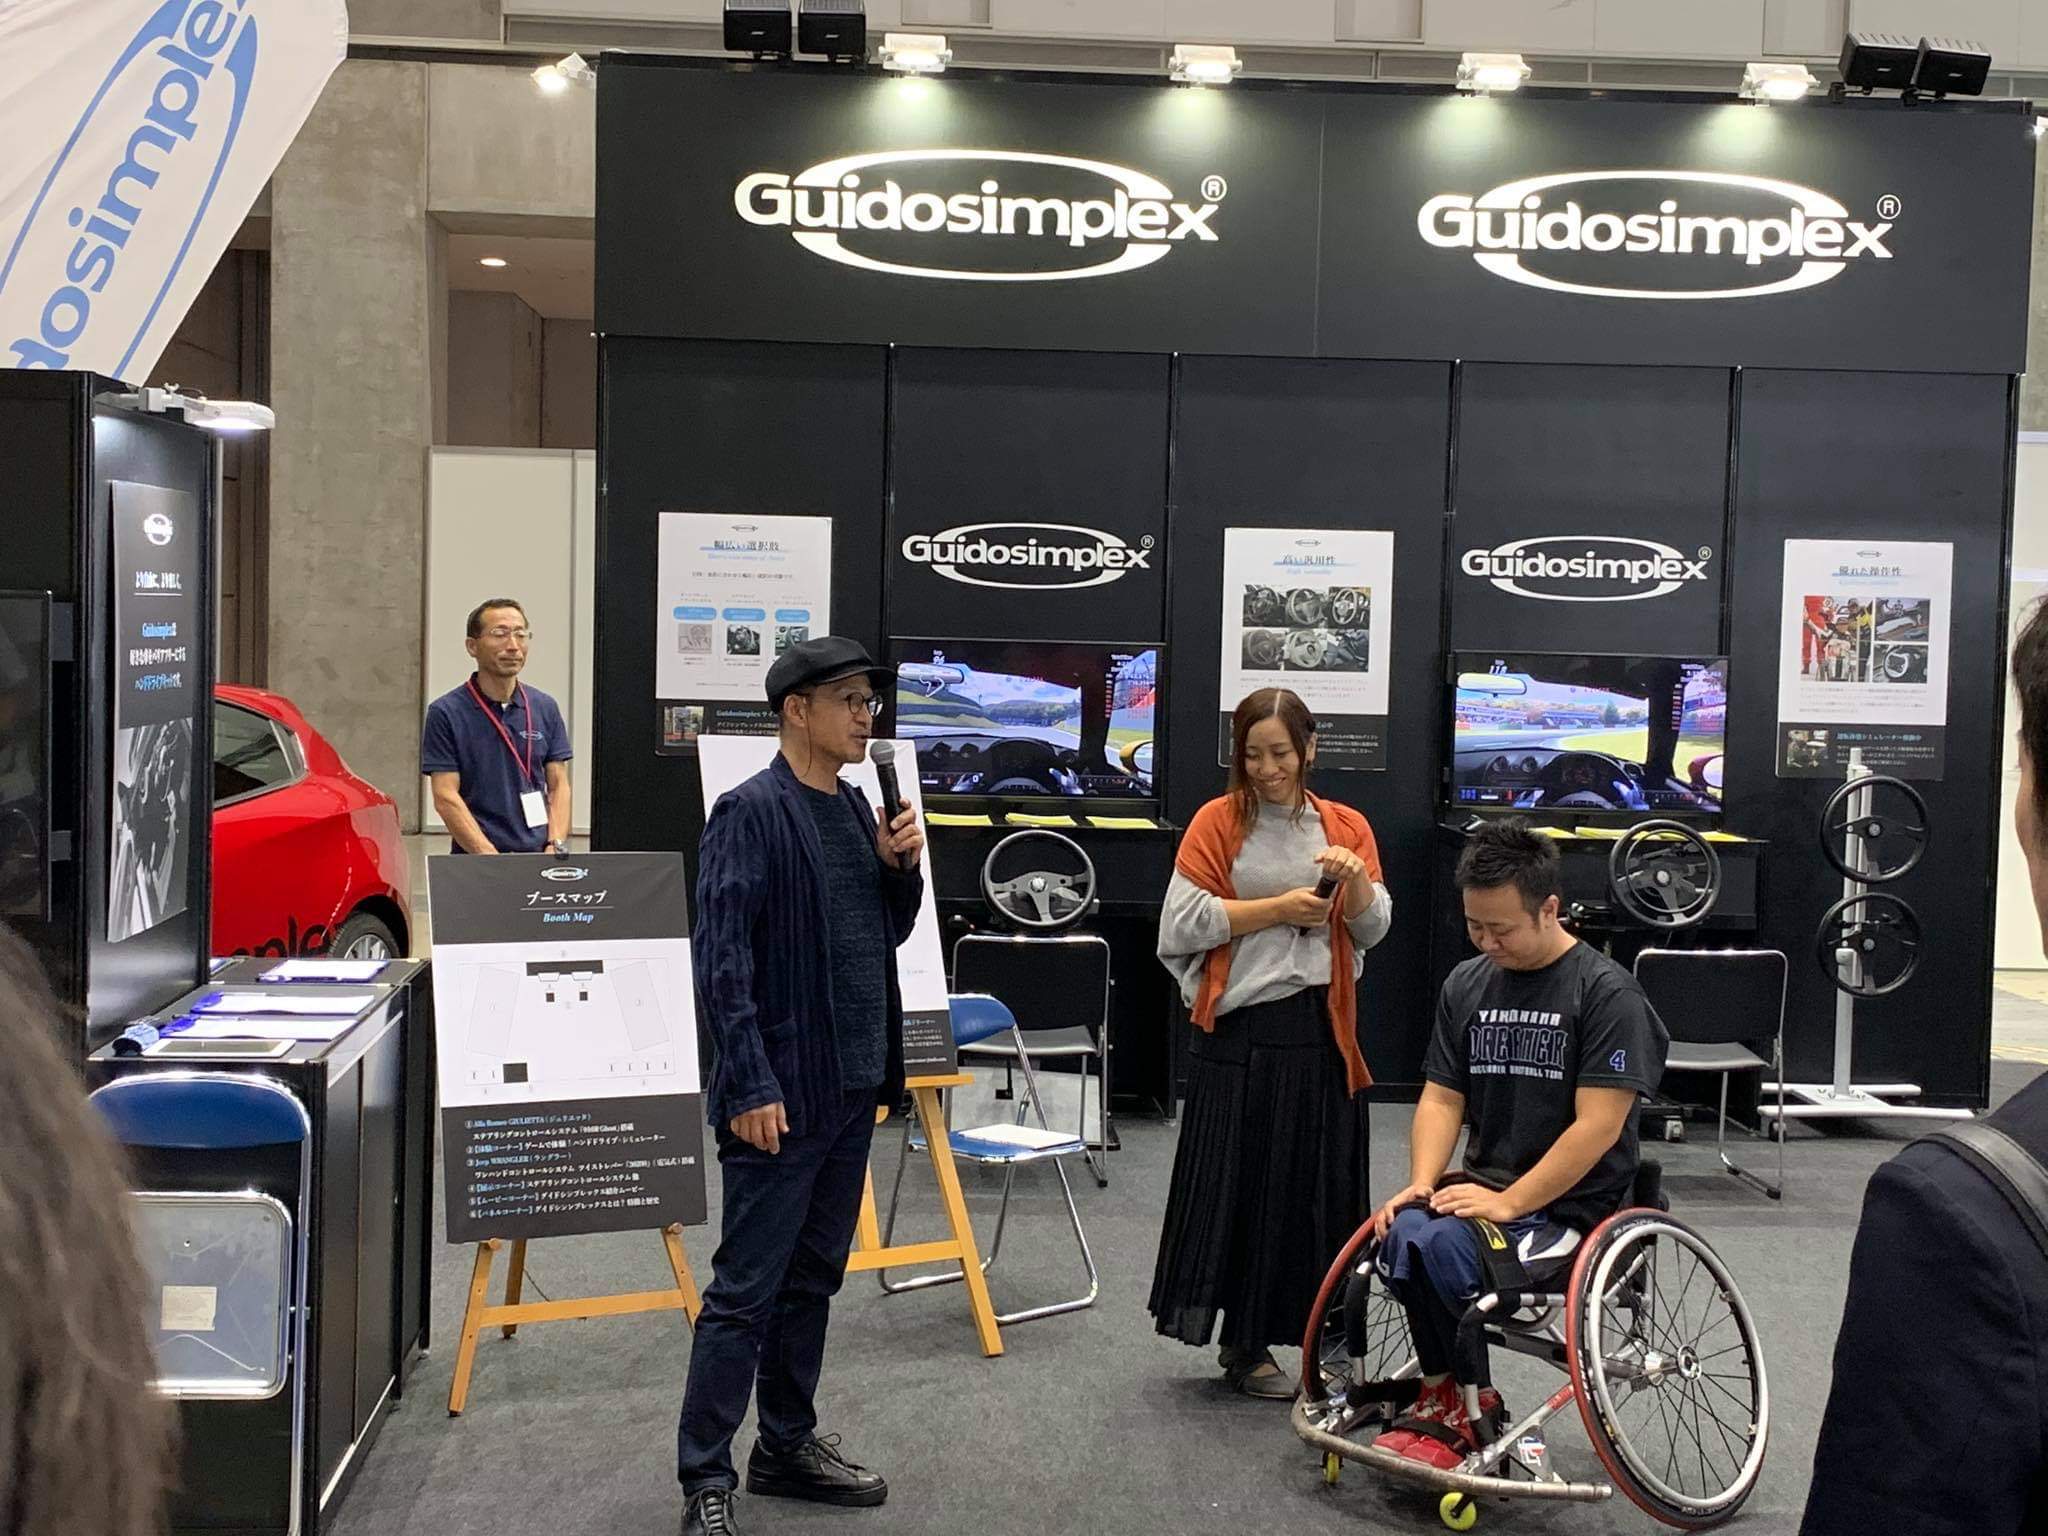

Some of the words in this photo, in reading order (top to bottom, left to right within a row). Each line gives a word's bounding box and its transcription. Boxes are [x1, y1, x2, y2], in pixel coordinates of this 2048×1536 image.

[733, 171, 1220, 248] Guidosimplex
[1416, 193, 1895, 267] Guidosimplex
[901, 534, 1151, 573] Guidosimplex
[1461, 546, 1709, 585] Guidosimplex
[526, 889, 608, 906] ブースマップ
[542, 912, 571, 923] Booth
[572, 911, 595, 924] Map
[1609, 1049, 1627, 1073] 4
